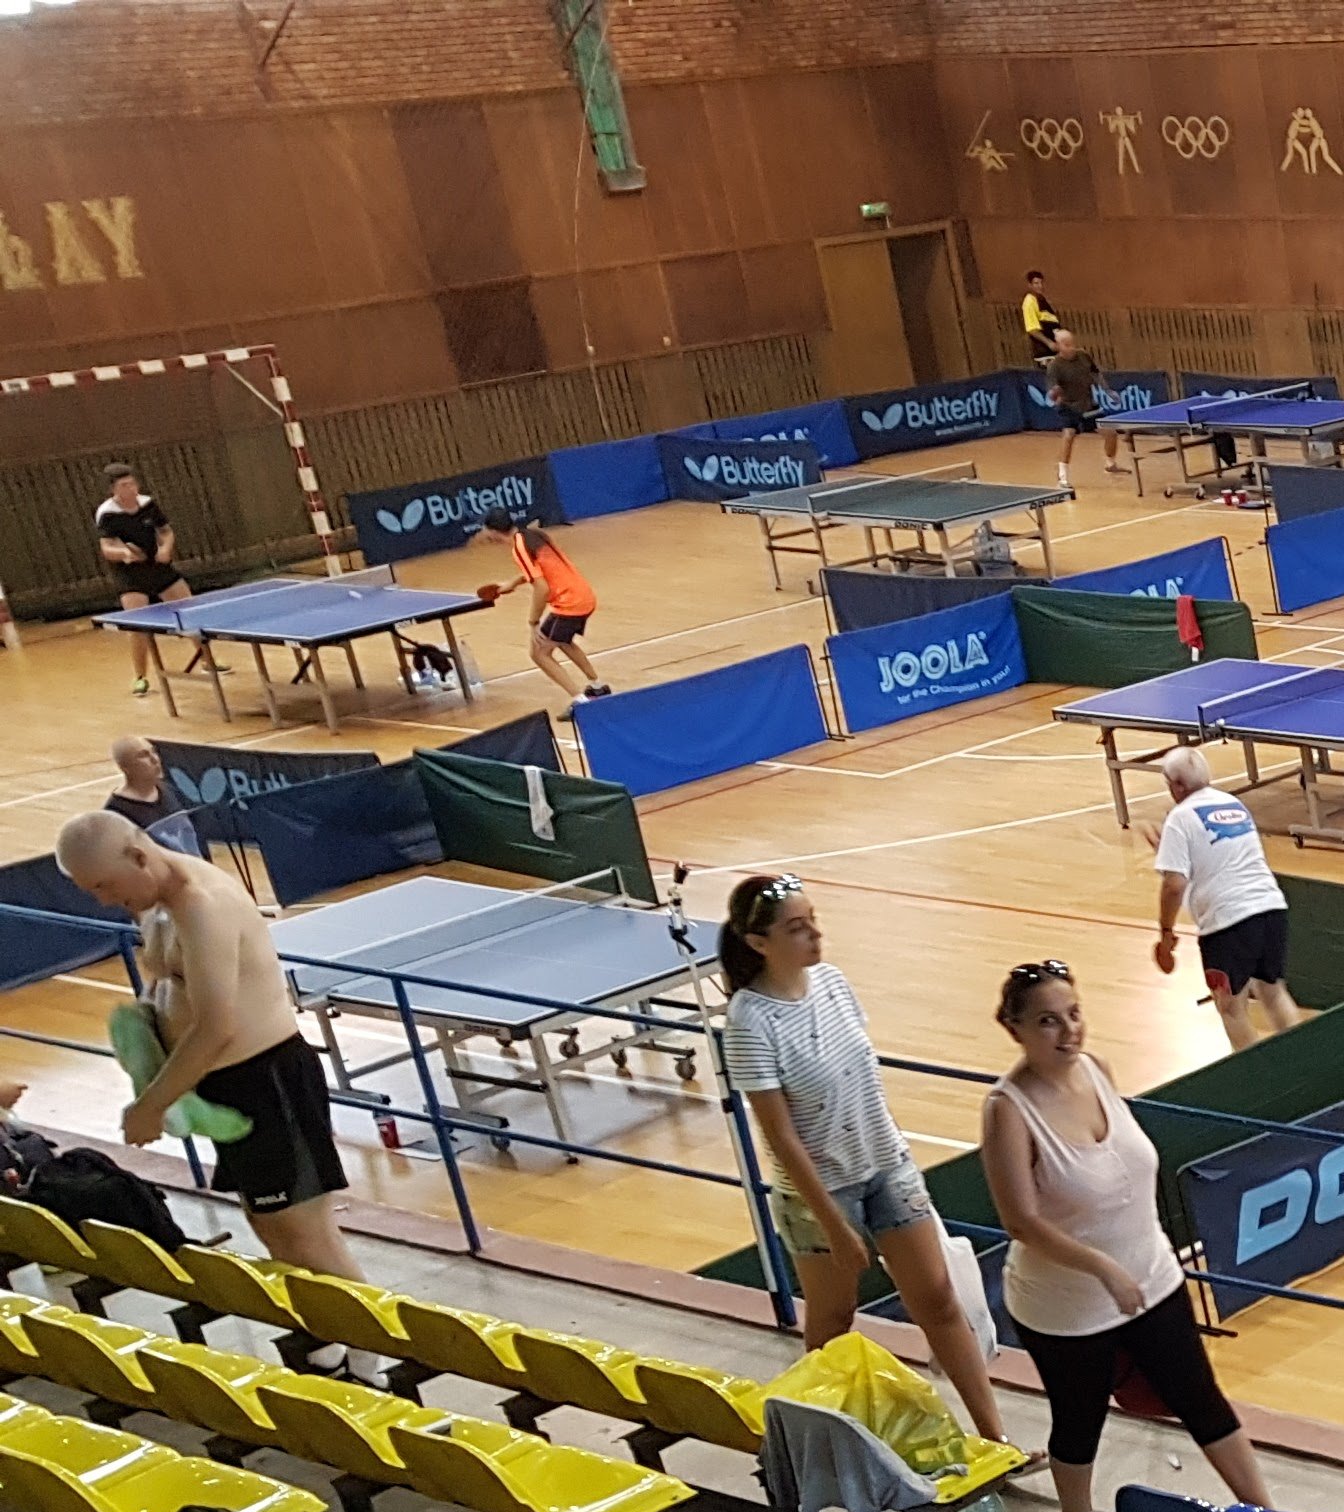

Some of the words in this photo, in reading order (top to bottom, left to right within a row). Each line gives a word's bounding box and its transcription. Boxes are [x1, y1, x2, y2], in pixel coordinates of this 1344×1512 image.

[904, 388, 999, 430] Butterfly
[719, 454, 804, 487] Butterfly
[877, 632, 990, 694] JOOLA
